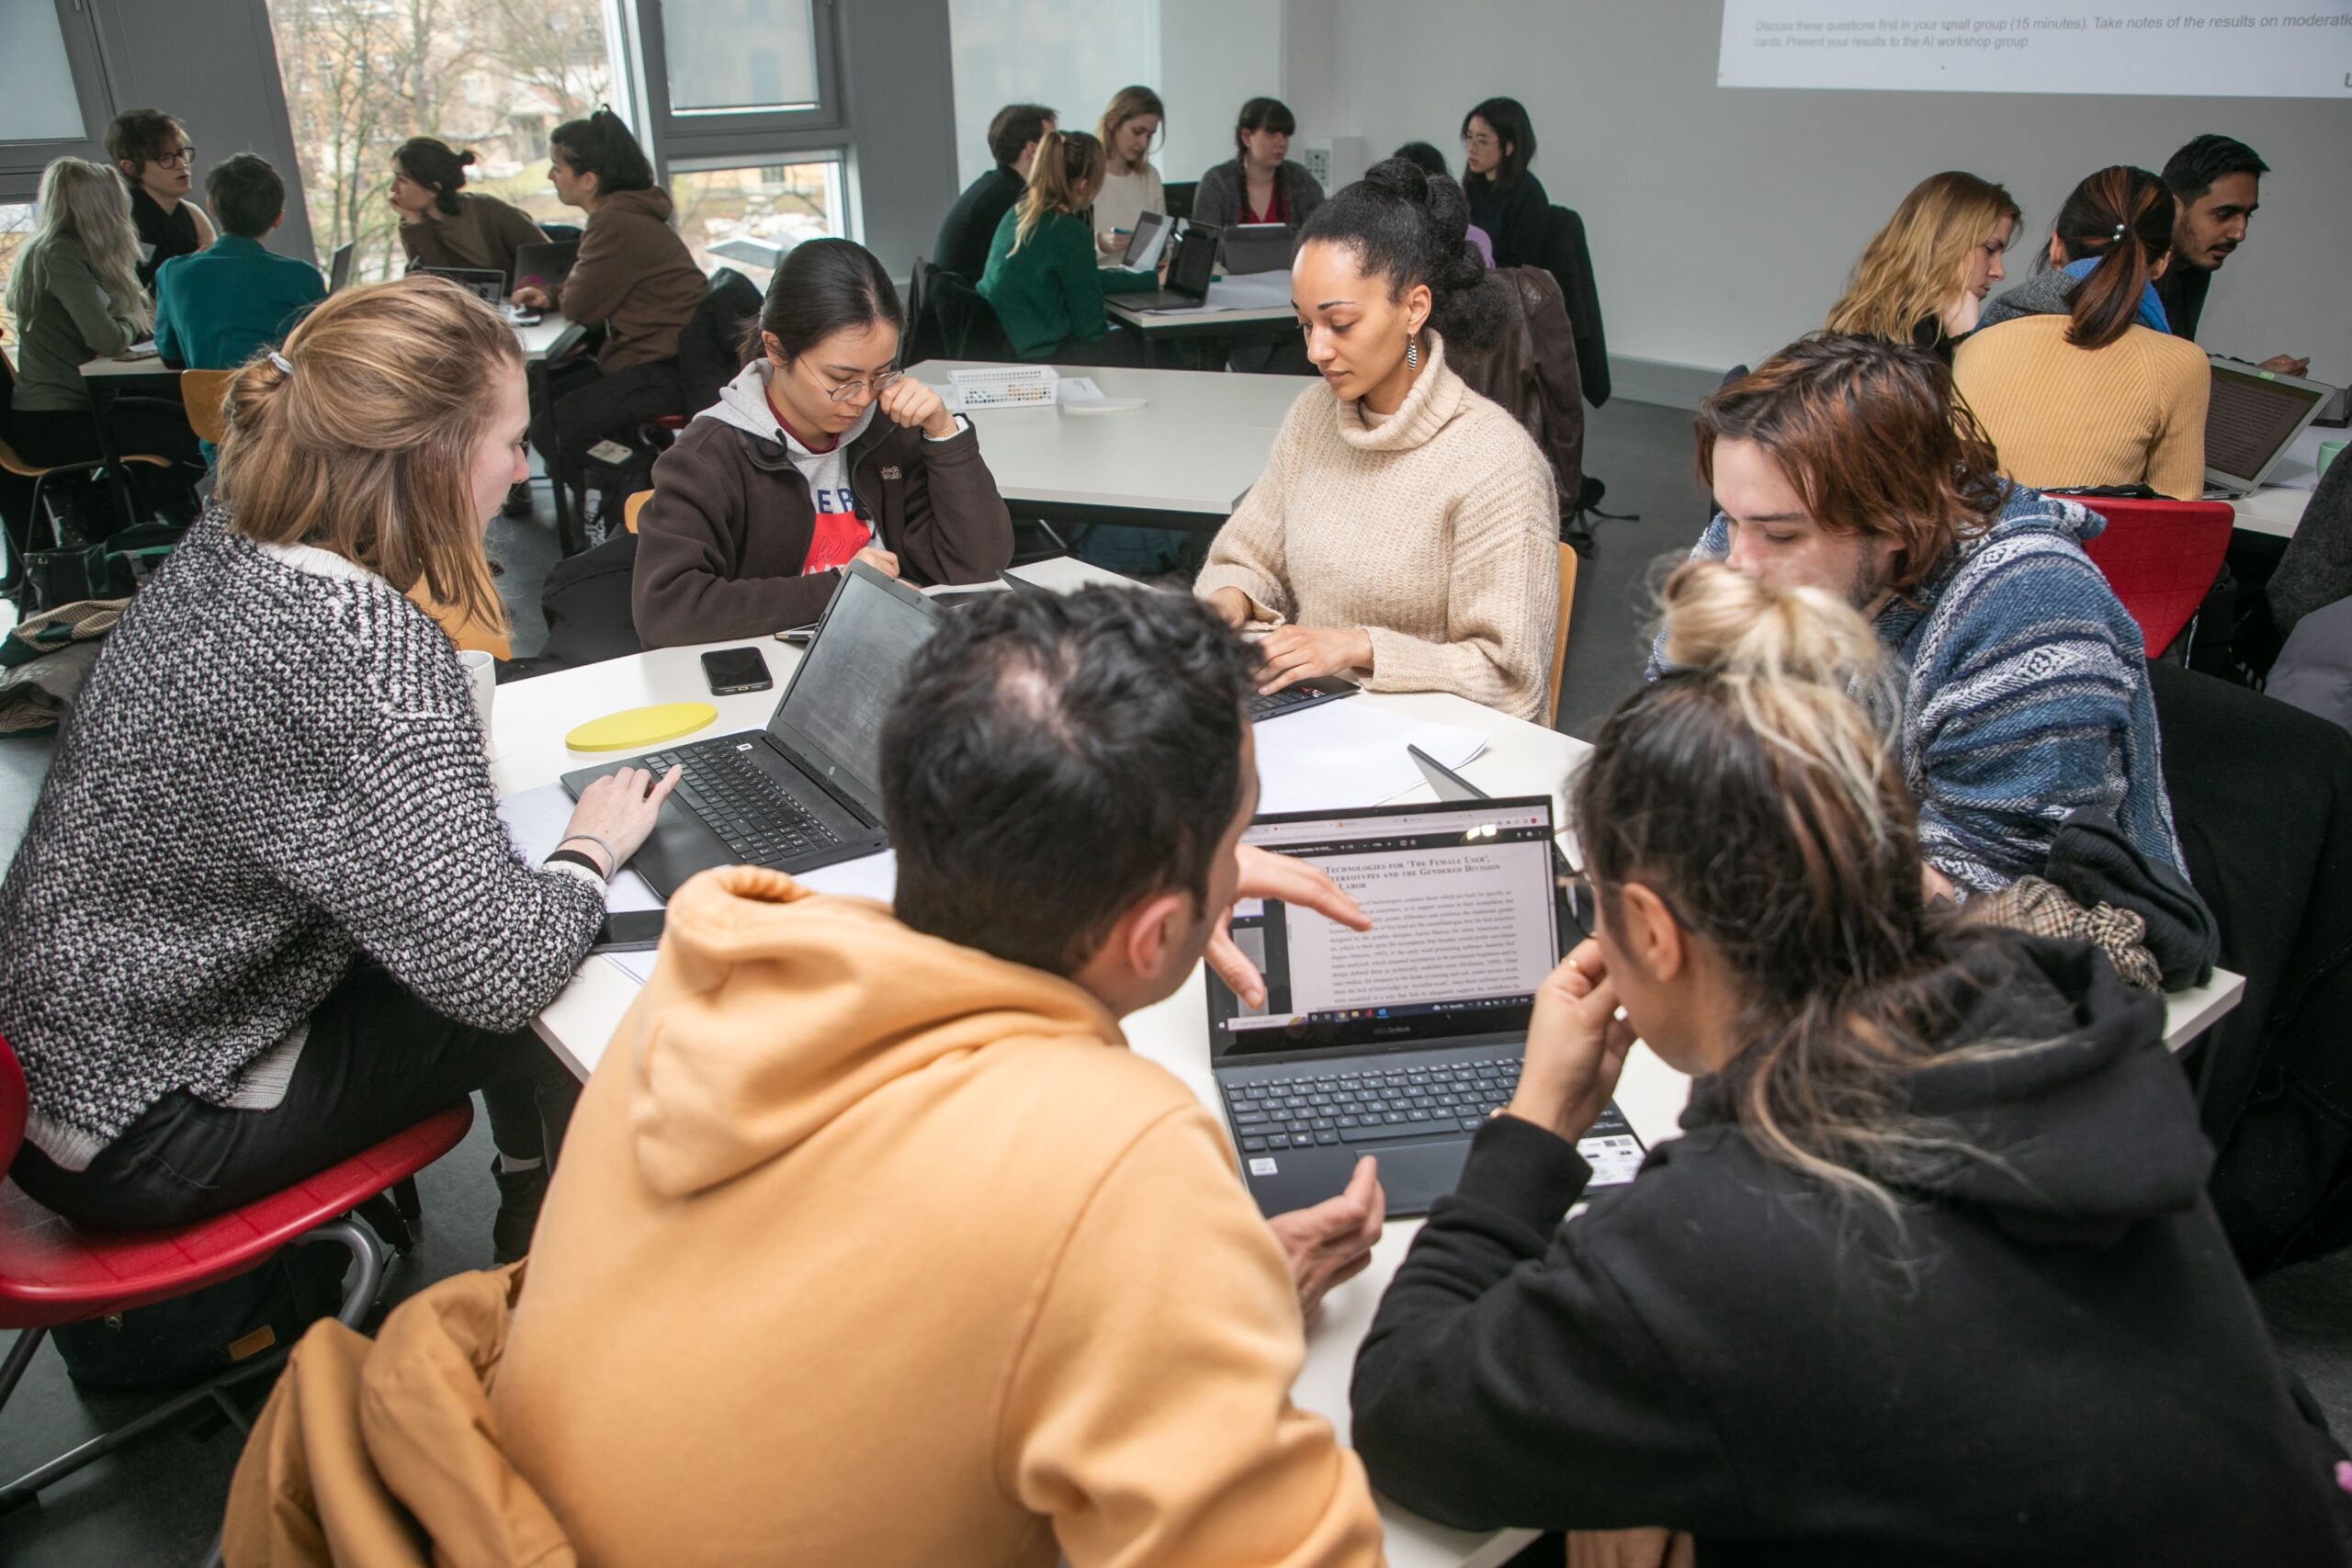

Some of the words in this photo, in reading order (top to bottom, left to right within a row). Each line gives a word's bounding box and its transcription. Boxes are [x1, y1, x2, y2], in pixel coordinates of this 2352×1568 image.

[1796, 20, 1823, 30] these
[1826, 19, 1875, 33] questions
[1879, 19, 1897, 30] first
[1901, 18, 1910, 29] in
[1913, 20, 1939, 32] your
[1940, 17, 1971, 30] small
[1973, 19, 2007, 32] group
[2010, 17, 2030, 31] (15
[2094, 16, 2123, 28] Take
[2127, 16, 2163, 28] notes
[2166, 15, 2182, 28] of
[2184, 15, 2205, 28] the
[2209, 14, 2256, 28] results
[2259, 16, 2278, 27] on
[1786, 35, 1826, 47] Present
[1827, 38, 1849, 49] your
[1852, 35, 1886, 47] results
[1890, 36, 1899, 47] to
[1902, 35, 1919, 46] the
[1937, 35, 1991, 49] workshop
[1995, 38, 2029, 50] group
[881, 466, 899, 474] Jack
